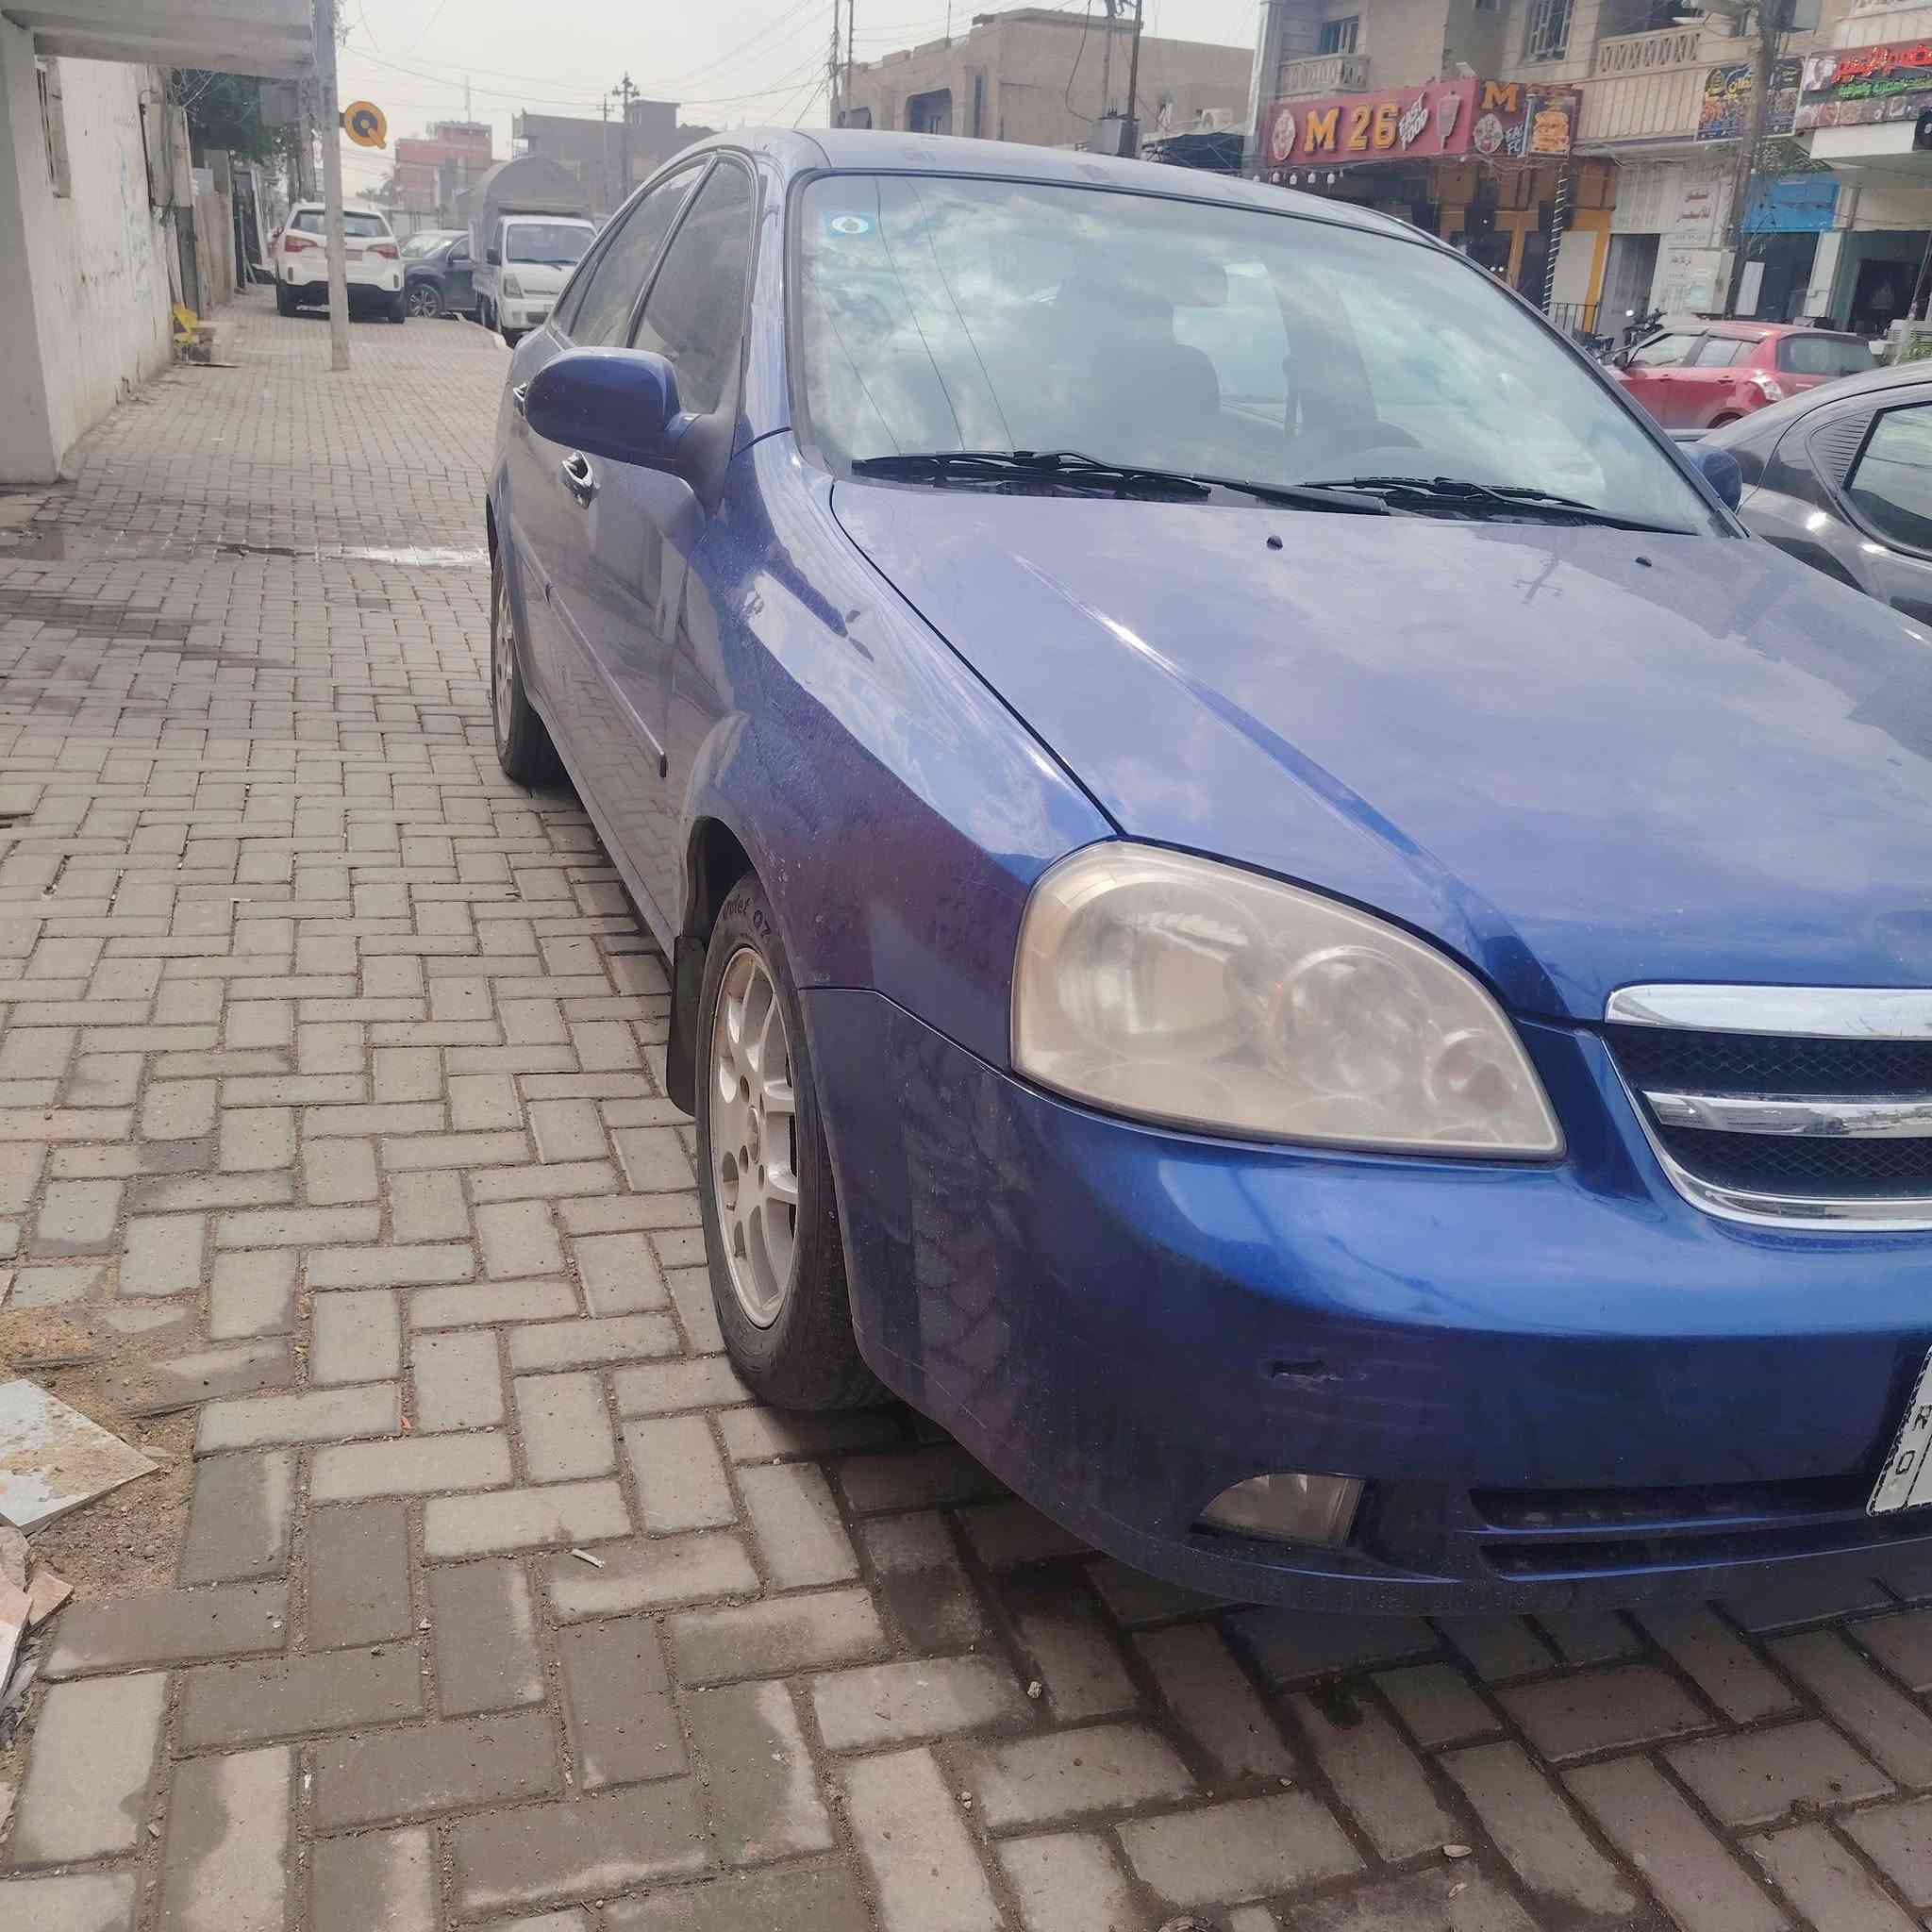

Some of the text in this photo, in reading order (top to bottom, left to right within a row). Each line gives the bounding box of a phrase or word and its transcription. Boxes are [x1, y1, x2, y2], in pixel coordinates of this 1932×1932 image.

[1399, 91, 1426, 137] FAST
[1482, 80, 1518, 112] M
[1304, 104, 1401, 152] M 26
[1401, 108, 1429, 151] FOOD
